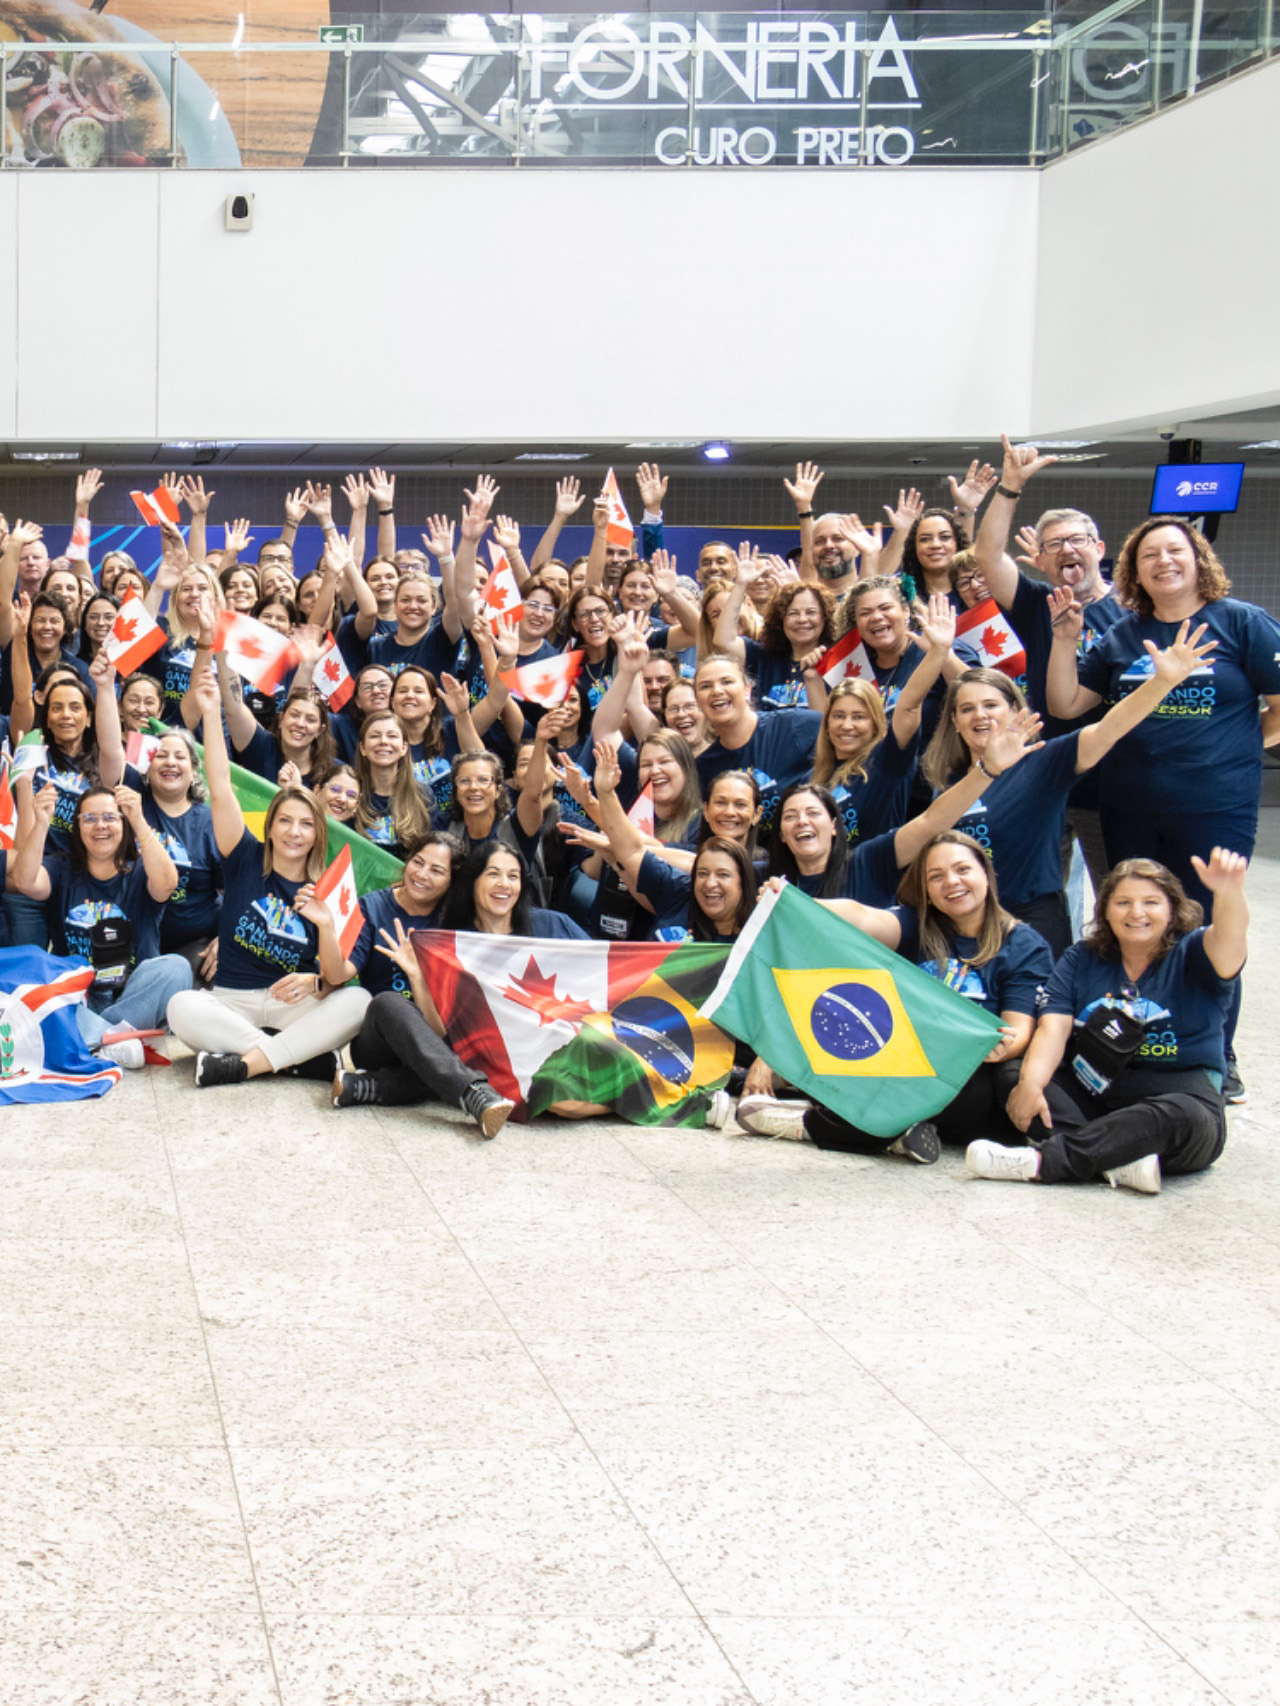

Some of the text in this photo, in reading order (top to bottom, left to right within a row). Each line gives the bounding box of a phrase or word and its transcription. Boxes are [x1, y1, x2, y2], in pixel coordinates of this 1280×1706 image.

[529, 15, 918, 102] FORNERIA
[797, 126, 915, 165] PRETO
[1193, 482, 1218, 491] CCR
